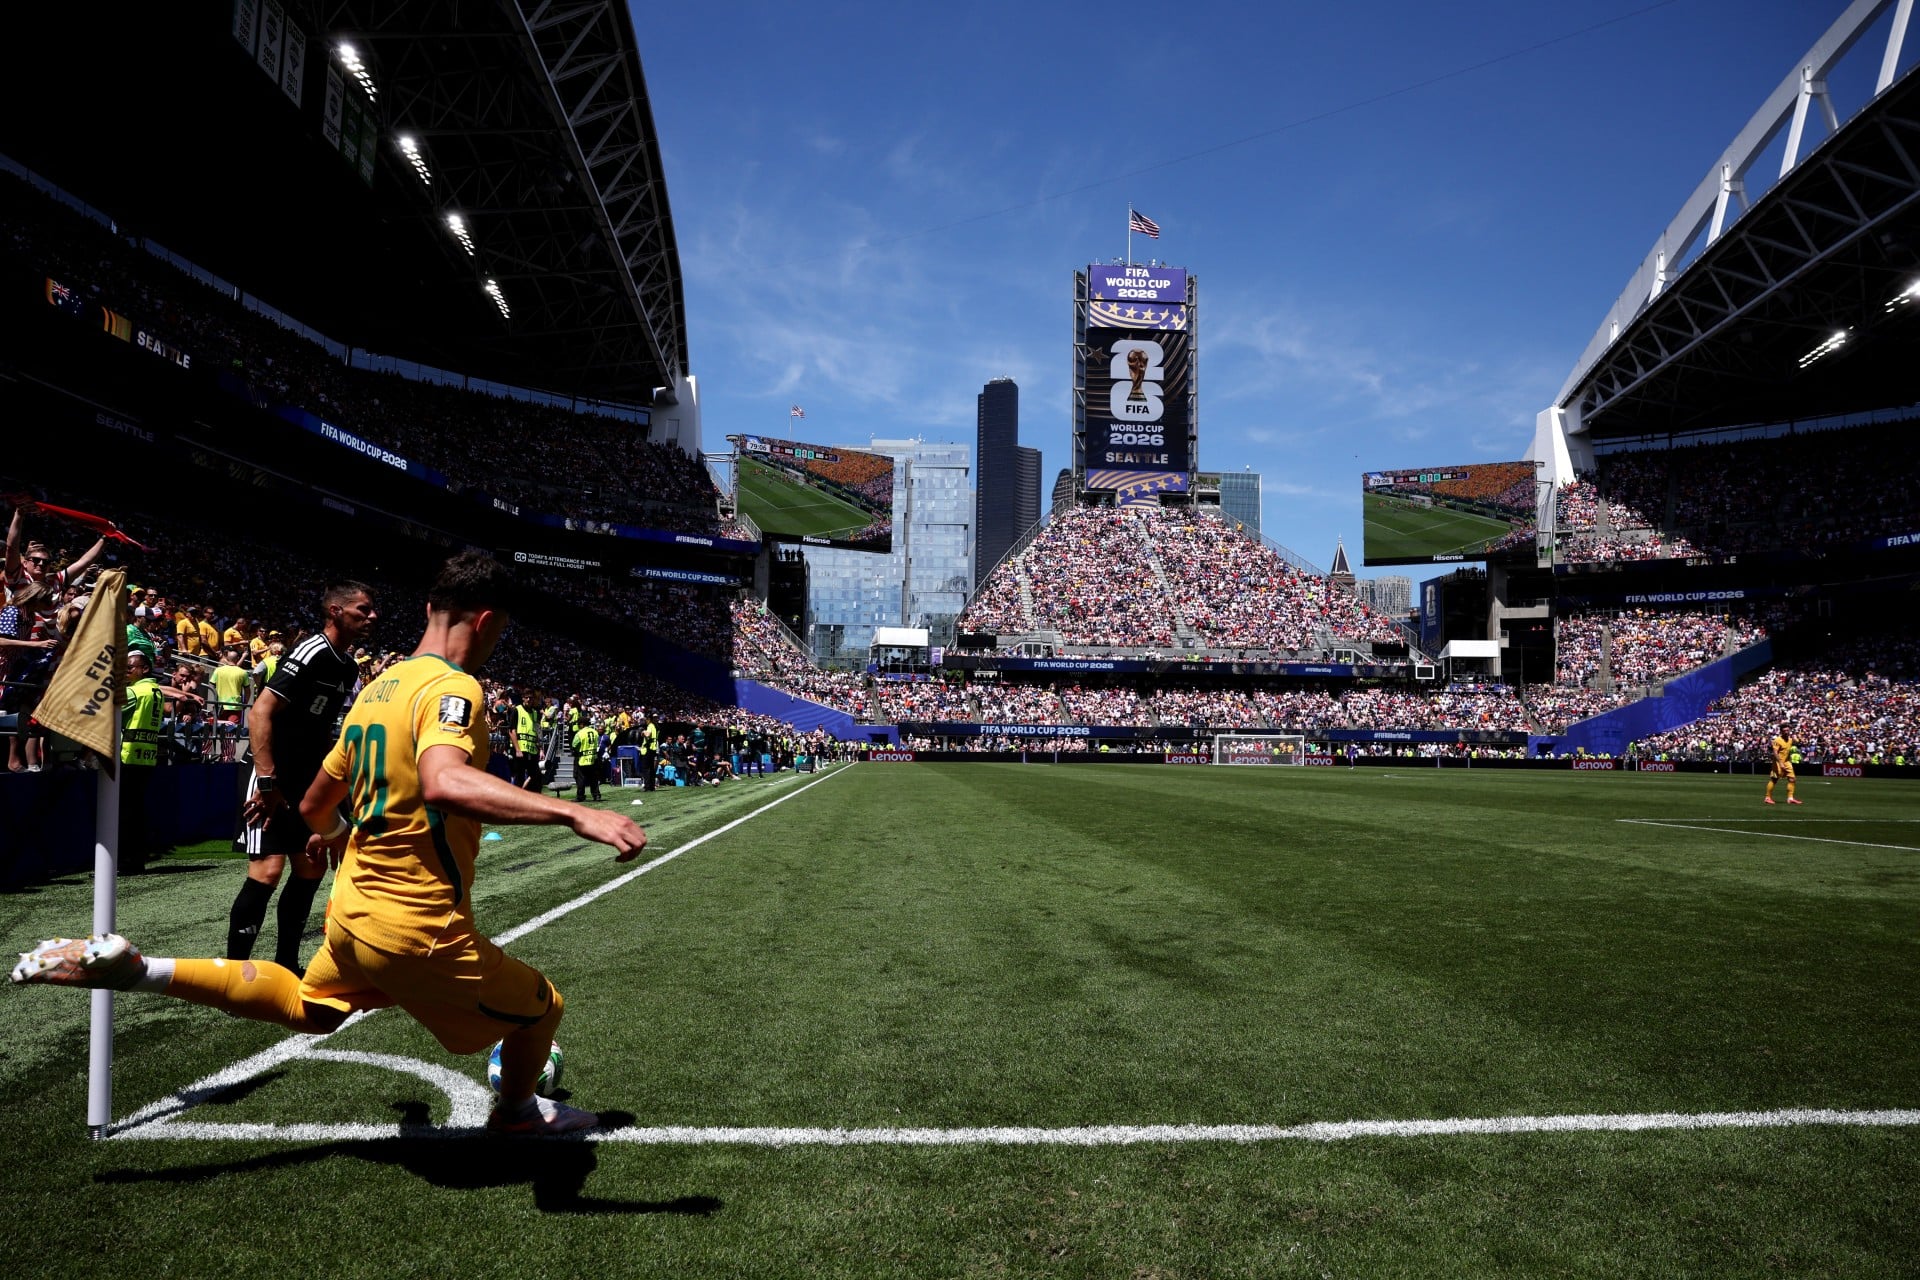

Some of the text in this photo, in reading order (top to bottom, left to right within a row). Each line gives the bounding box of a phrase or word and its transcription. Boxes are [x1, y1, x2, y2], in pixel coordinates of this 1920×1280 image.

[1125, 268, 1150, 278] FIFA
[1106, 278, 1171, 289] WORLD CUP
[1118, 288, 1158, 299] 2026
[1125, 405, 1150, 414] FIFA
[1110, 424, 1164, 433] WORLD CUP
[1109, 432, 1164, 446] 2026
[321, 422, 407, 471] FIFA WORLD CUP 2026
[1105, 452, 1169, 464] SEATTLE
[803, 535, 831, 545] Hisense
[1888, 536, 1910, 547] FIFA
[1685, 556, 1737, 567] SEALE
[645, 569, 726, 583] FIFA WORLD CUP 2026
[1625, 590, 1745, 603] FIFA WORLD CUP 2026
[85, 644, 117, 681] FIFA
[284, 661, 299, 672] FIFA
[80, 670, 117, 716] WOR
[980, 725, 1090, 735] FIFA WORLD CUP 2026
[869, 751, 913, 761] Lenovo
[1165, 754, 1207, 764] Lenovo
[1228, 754, 1271, 764] Lenovo
[1572, 760, 1613, 770] Lenovo
[1640, 761, 1674, 771] Lenovo
[1823, 764, 1862, 776] Lenovo
